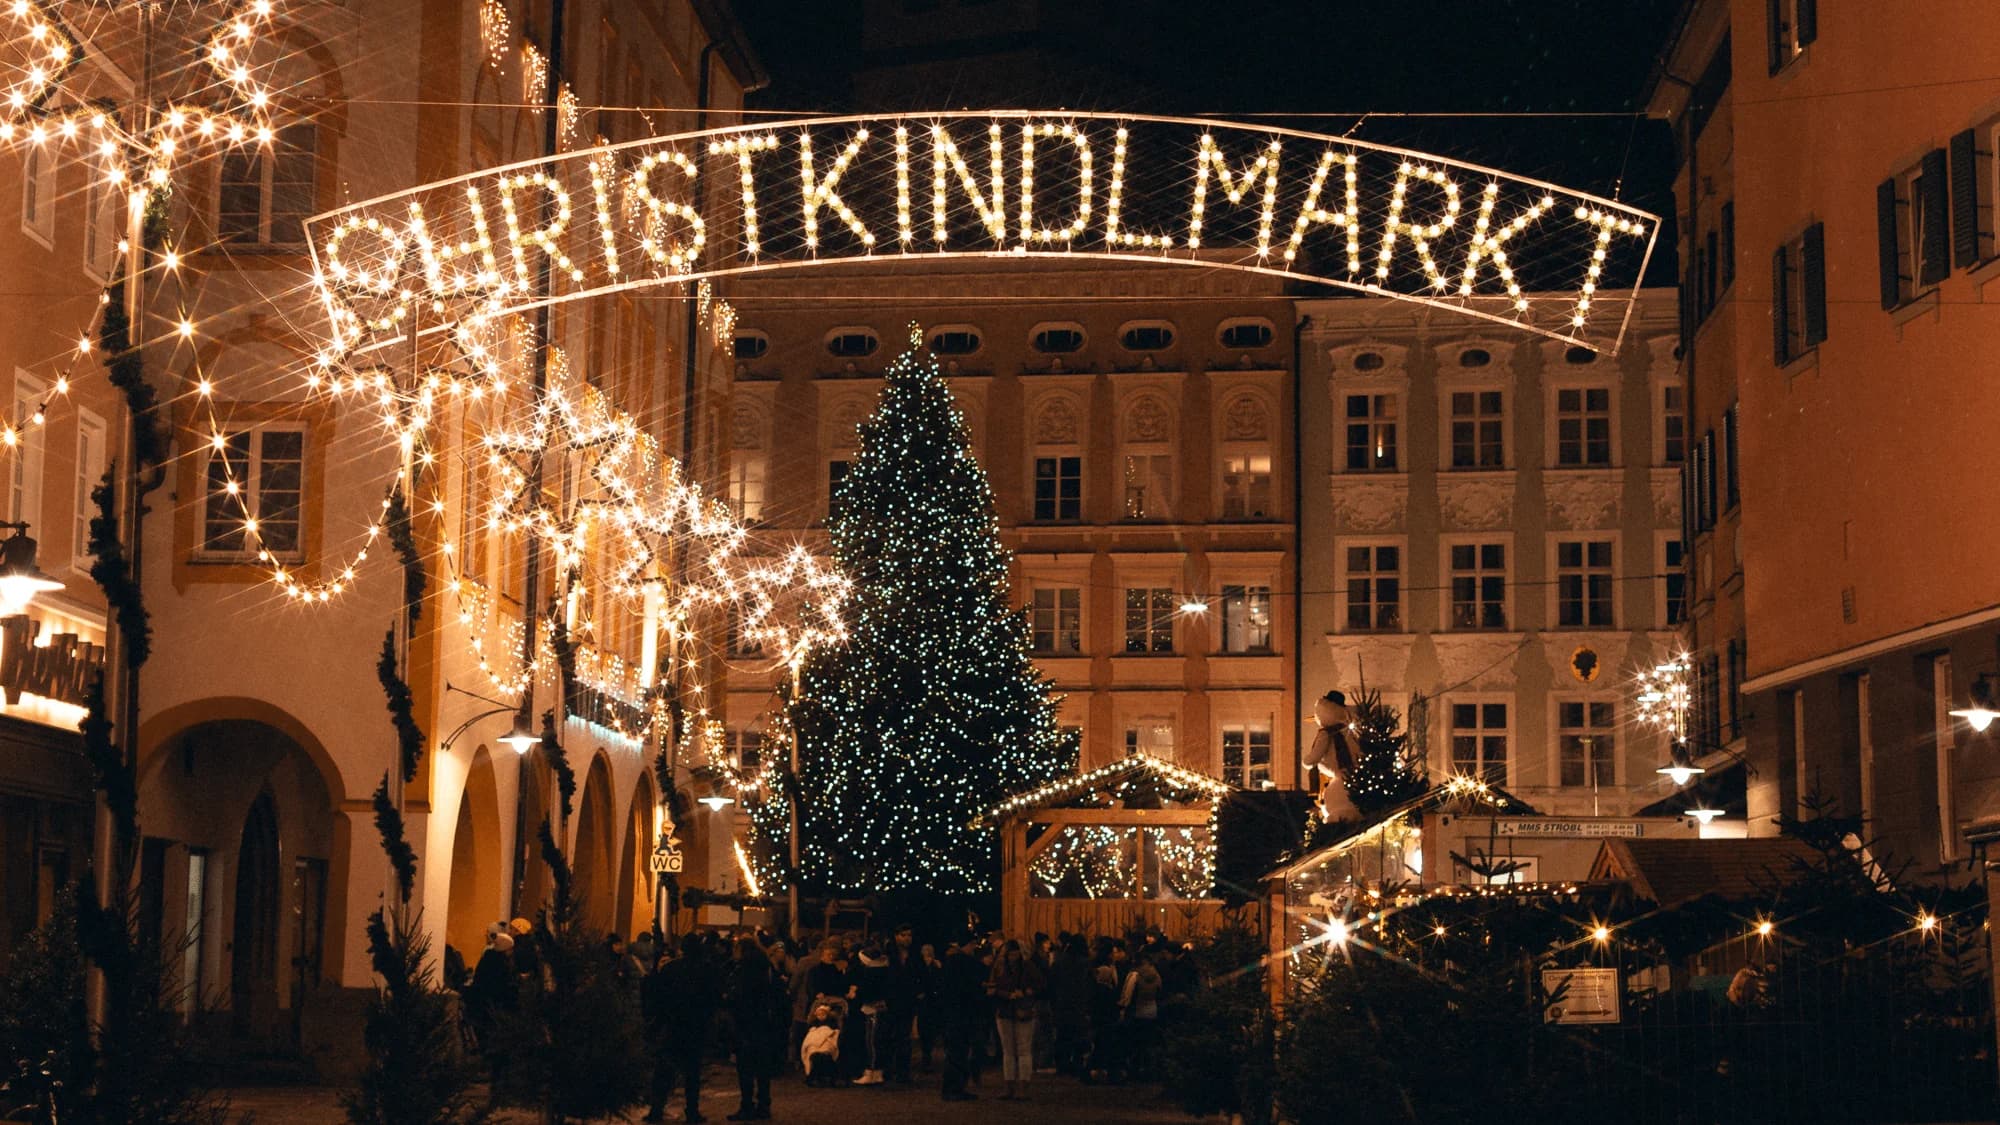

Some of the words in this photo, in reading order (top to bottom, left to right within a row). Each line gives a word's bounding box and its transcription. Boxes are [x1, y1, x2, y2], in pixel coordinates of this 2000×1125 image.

[324, 120, 1647, 328] CHRISTKINDLMARKT
[1517, 823, 1541, 832] MMS
[652, 856, 681, 870] WC
